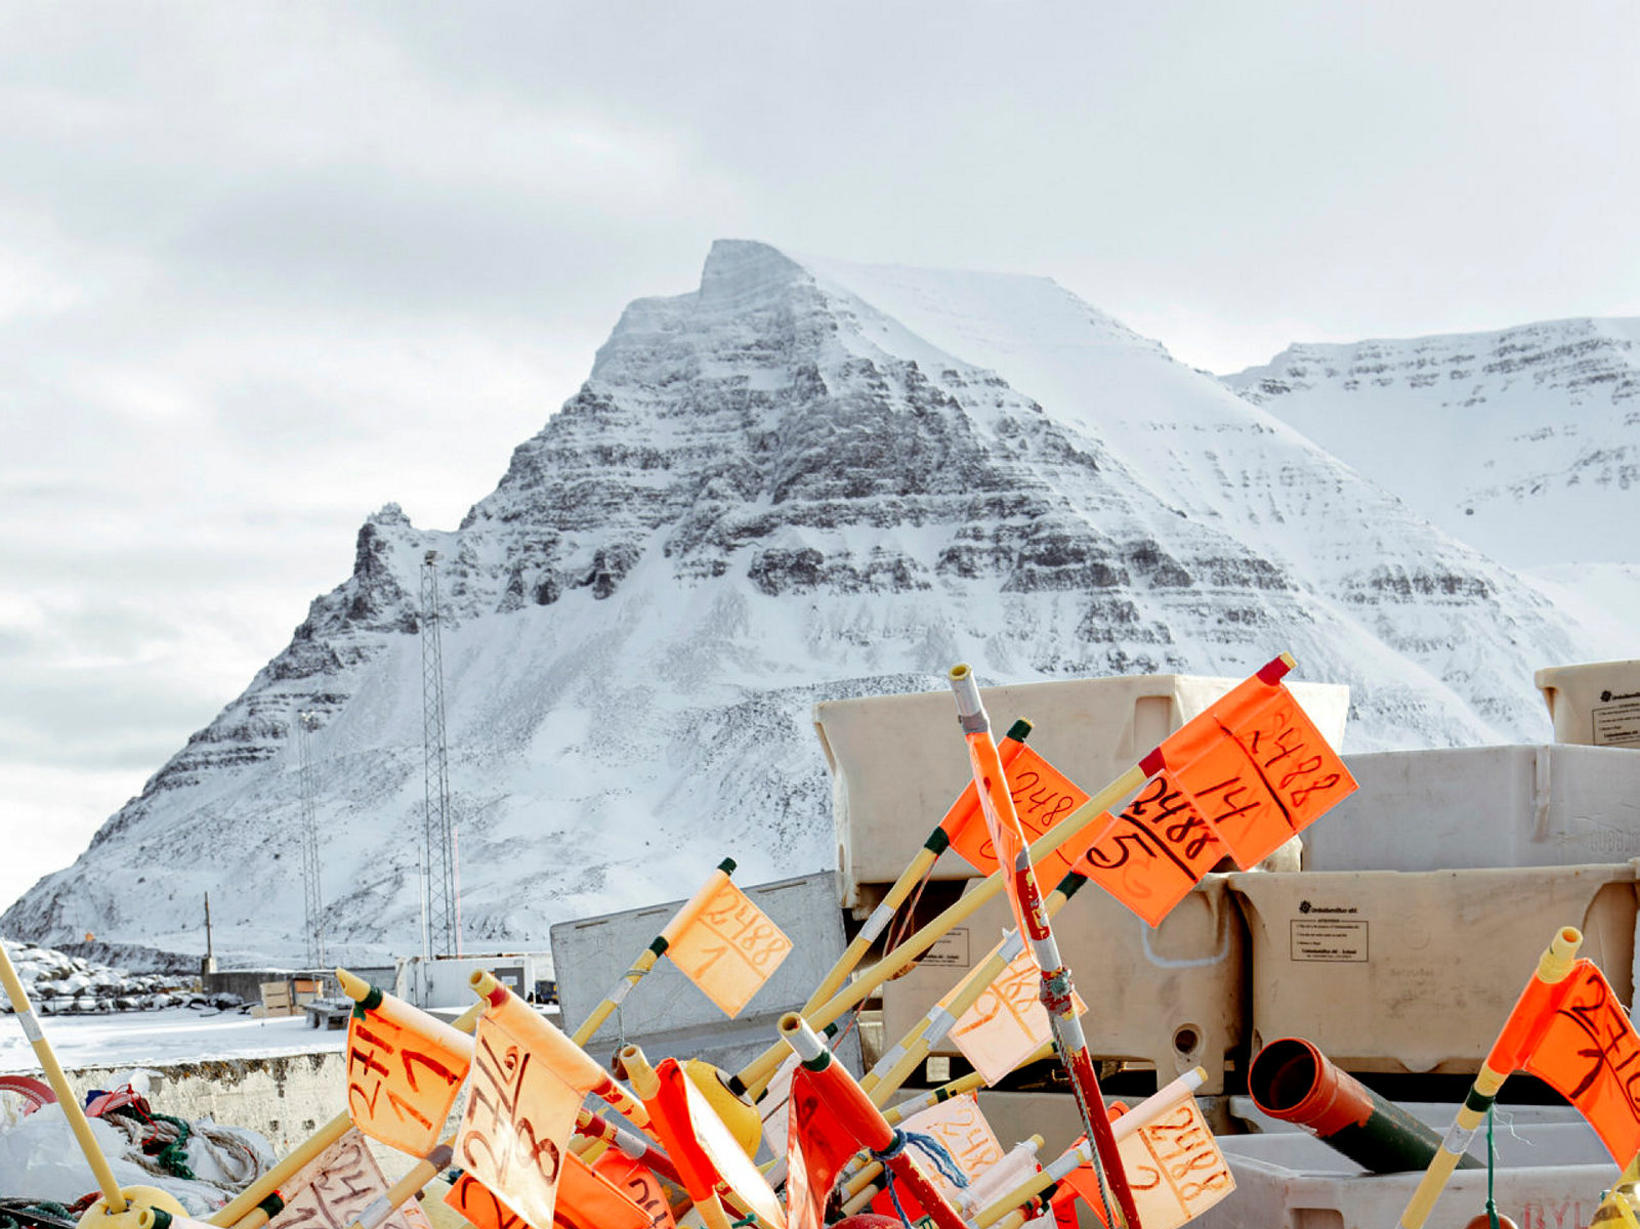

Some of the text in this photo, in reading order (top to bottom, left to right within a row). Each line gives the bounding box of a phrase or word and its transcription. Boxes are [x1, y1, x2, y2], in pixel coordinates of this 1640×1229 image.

[1248, 712, 1341, 808] 2488
[1011, 771, 1074, 828] 248
[1129, 776, 1220, 860] 2488
[1193, 776, 1261, 824] 14
[706, 890, 786, 966] 2488
